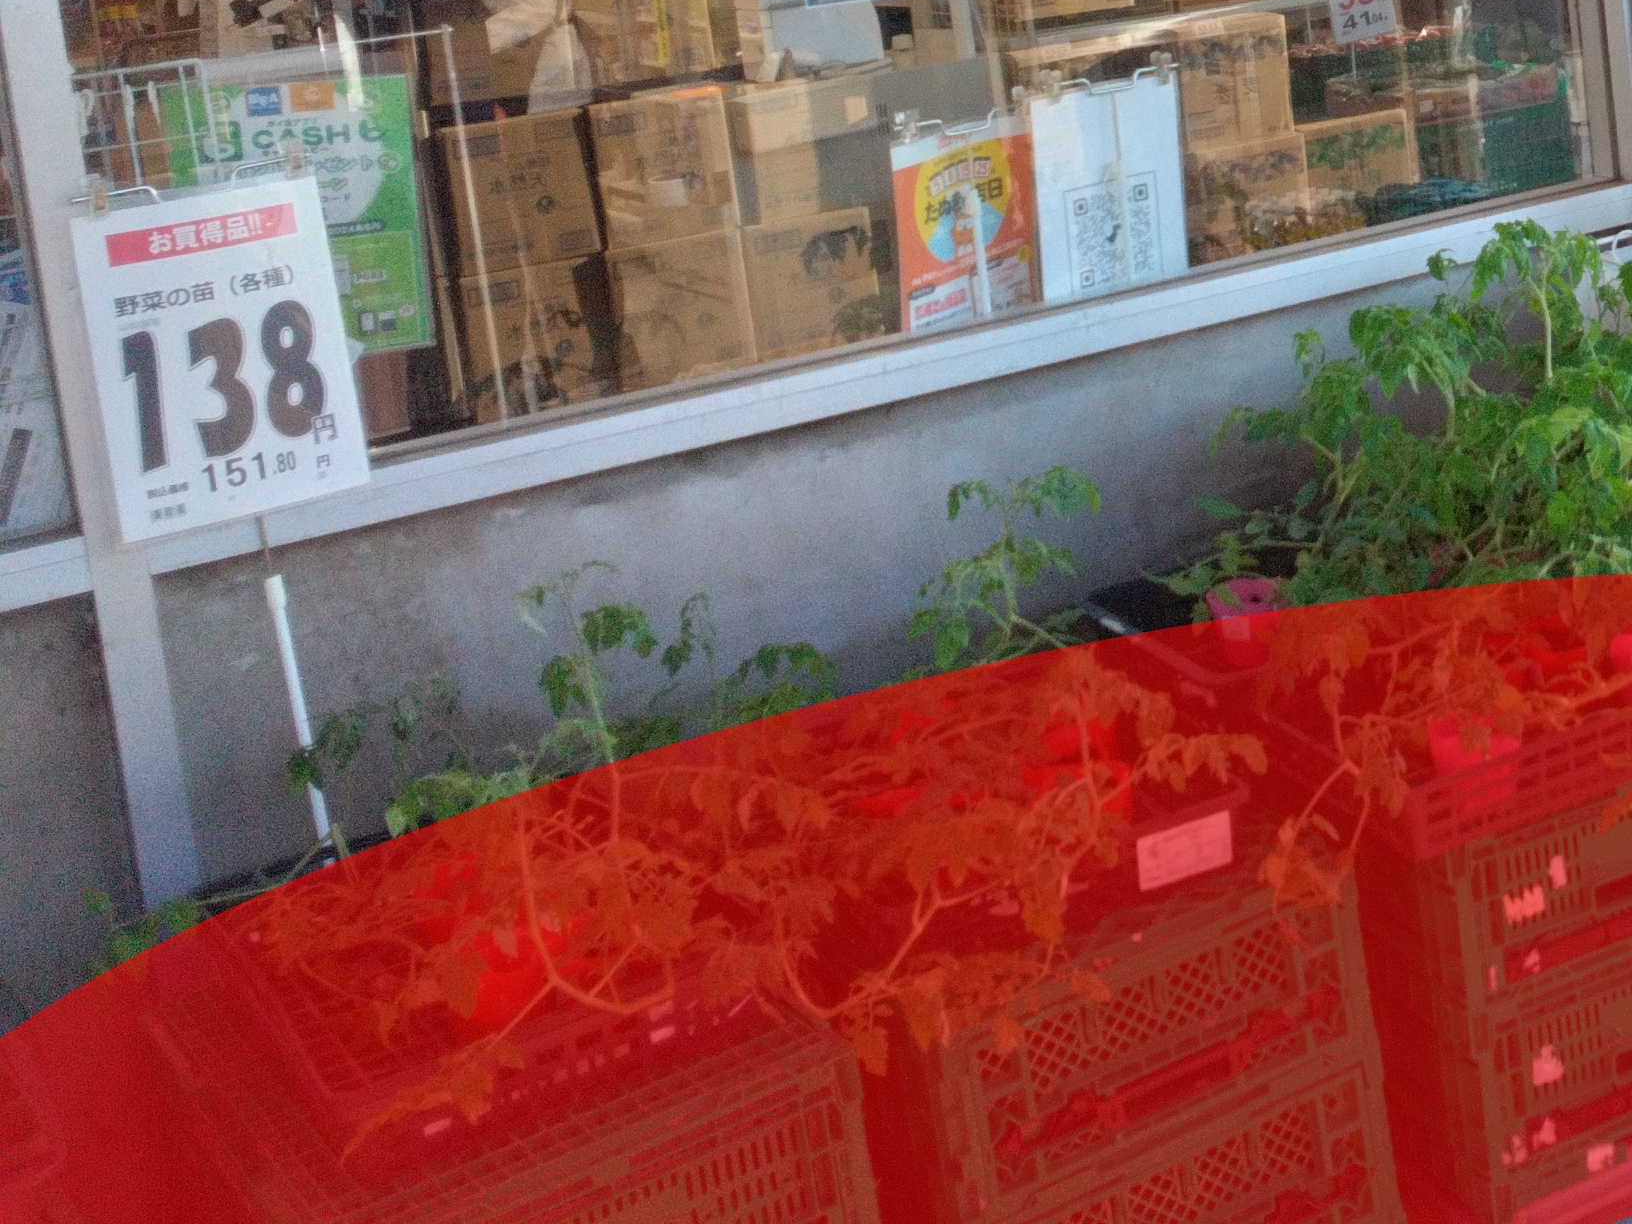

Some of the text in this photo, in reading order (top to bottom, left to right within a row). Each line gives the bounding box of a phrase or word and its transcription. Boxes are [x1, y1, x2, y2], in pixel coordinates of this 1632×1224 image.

[113, 265, 295, 318] 野菜の苗（各種）
[118, 299, 326, 474] 138
[313, 414, 339, 444] 円
[202, 451, 297, 493] 151.80
